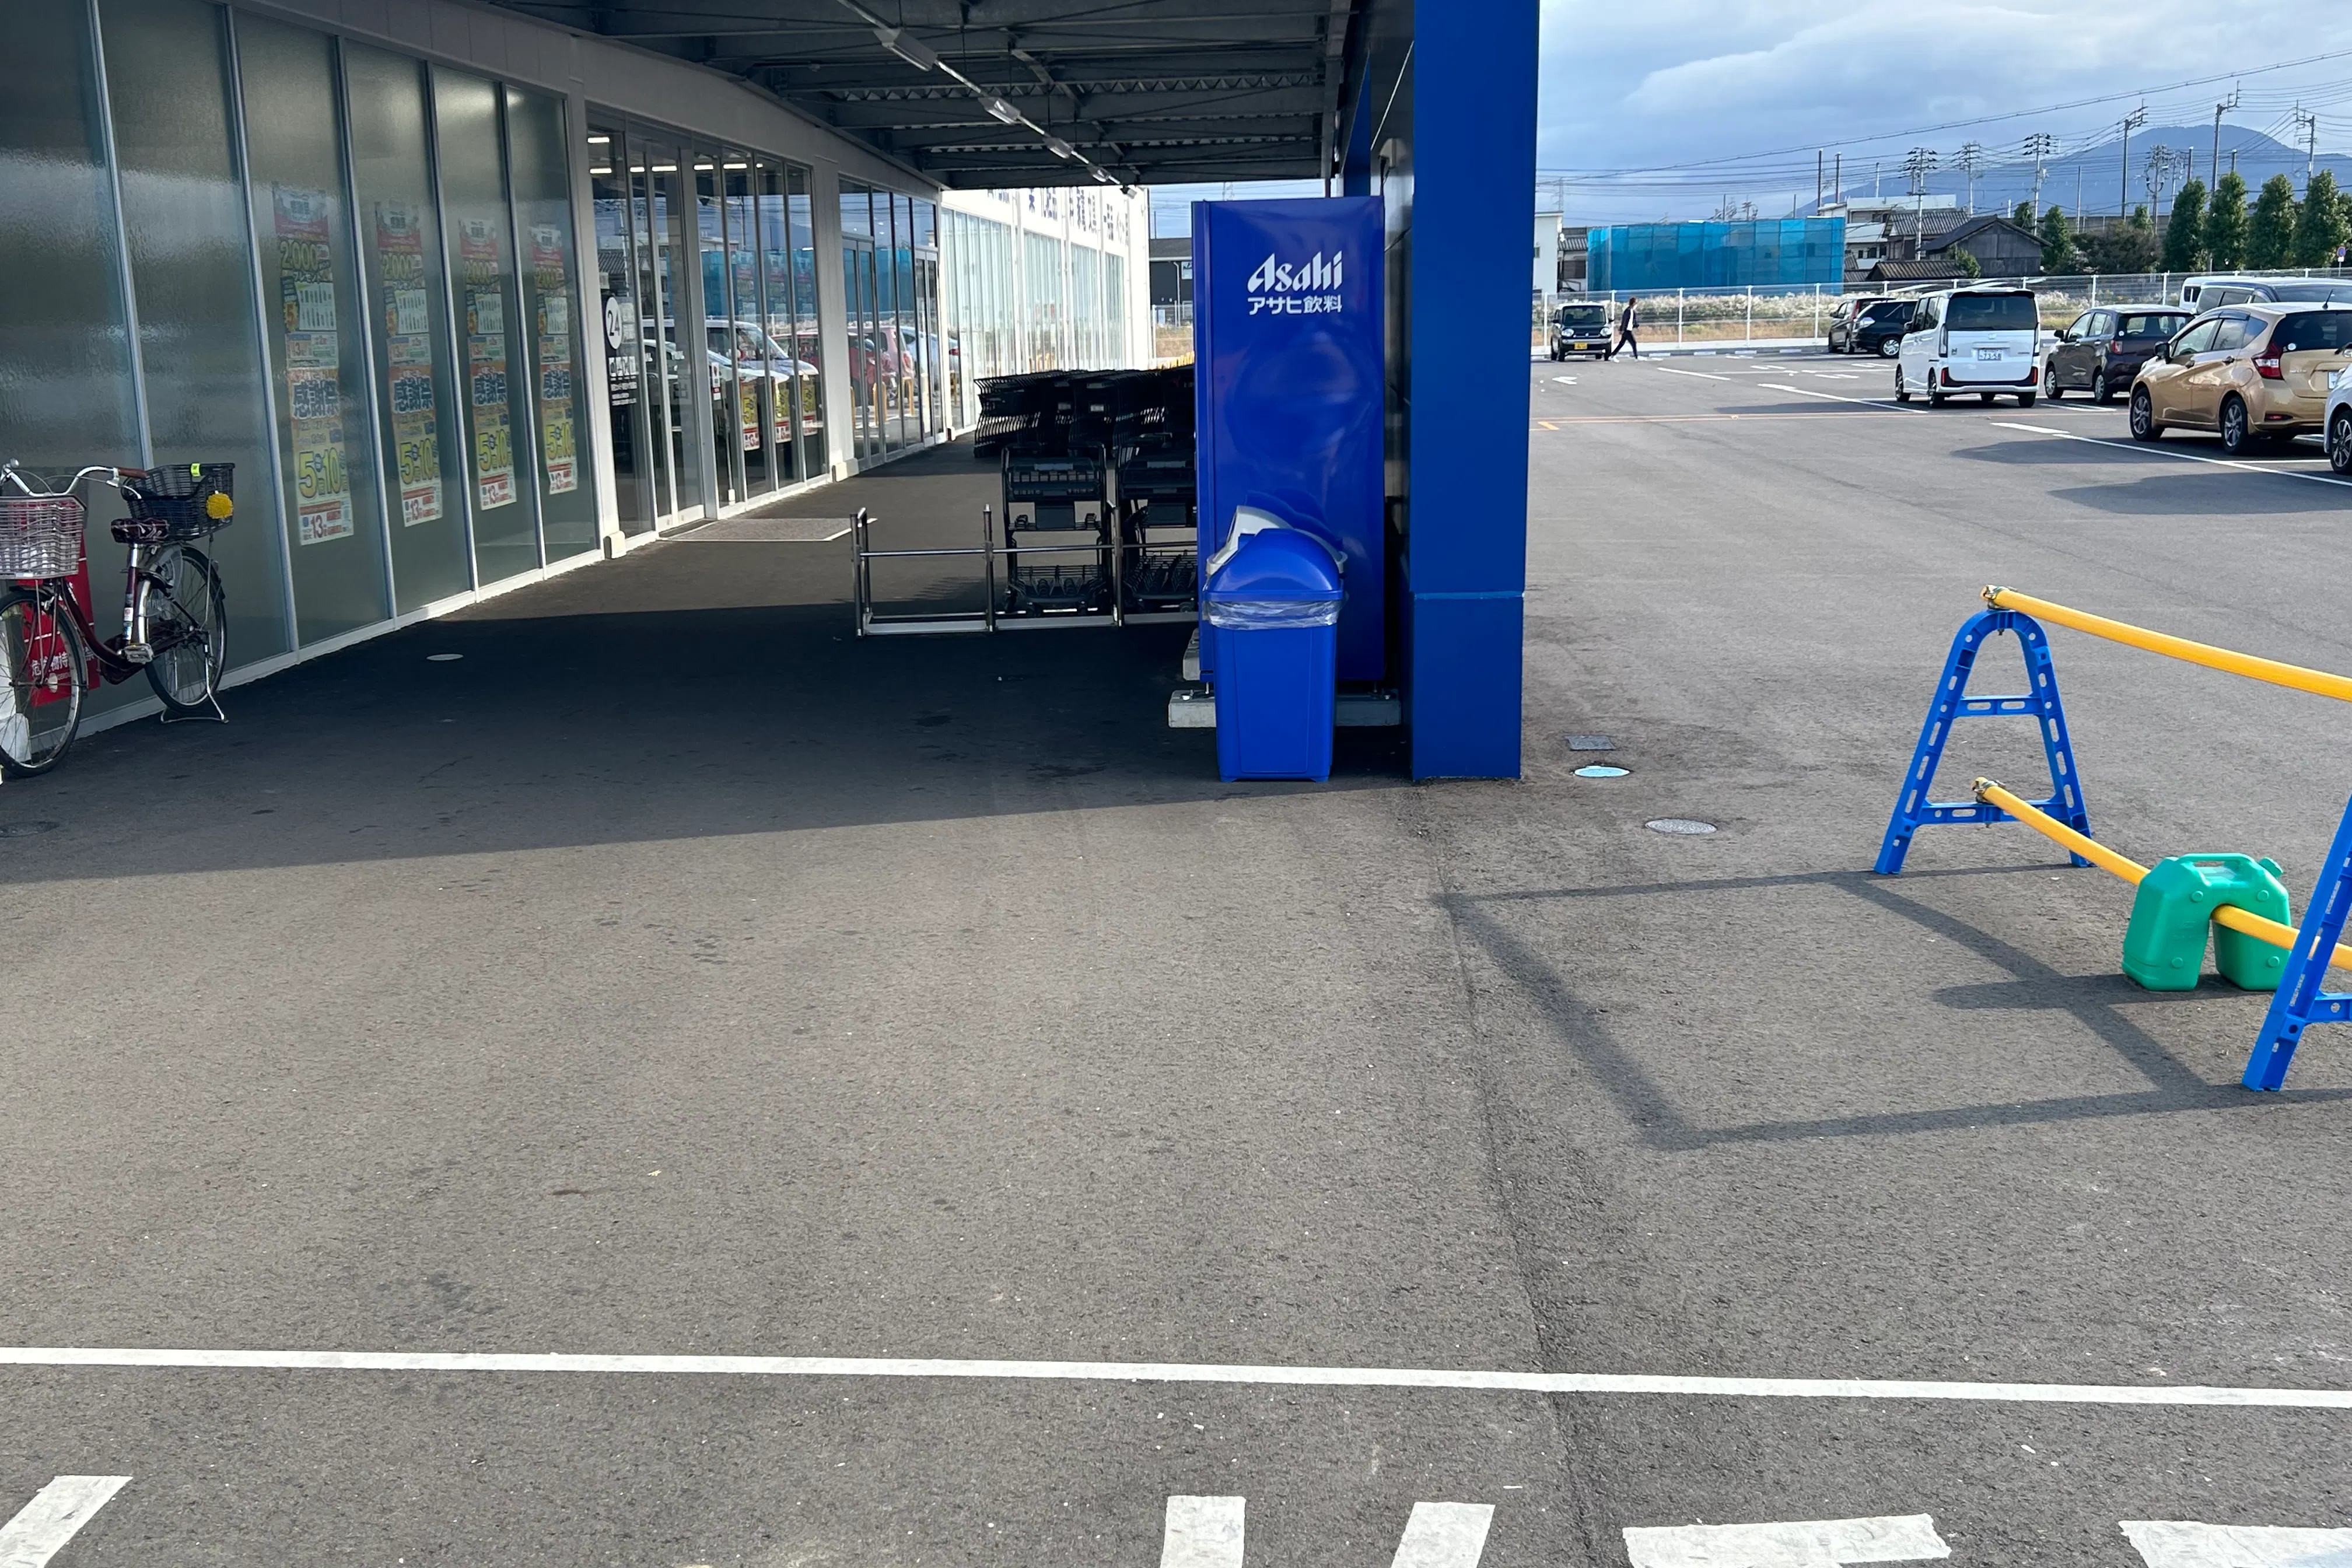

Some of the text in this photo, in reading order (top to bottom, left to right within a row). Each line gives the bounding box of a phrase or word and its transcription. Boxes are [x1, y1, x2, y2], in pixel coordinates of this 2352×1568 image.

[1247, 250, 1342, 293] Asahi
[607, 310, 621, 337] 24
[1247, 295, 1342, 316] アサヒ飲料
[293, 380, 340, 418] 感謝祭
[400, 441, 414, 485] 5
[478, 432, 492, 472] 5
[299, 450, 317, 498] 5
[310, 514, 324, 539] 13
